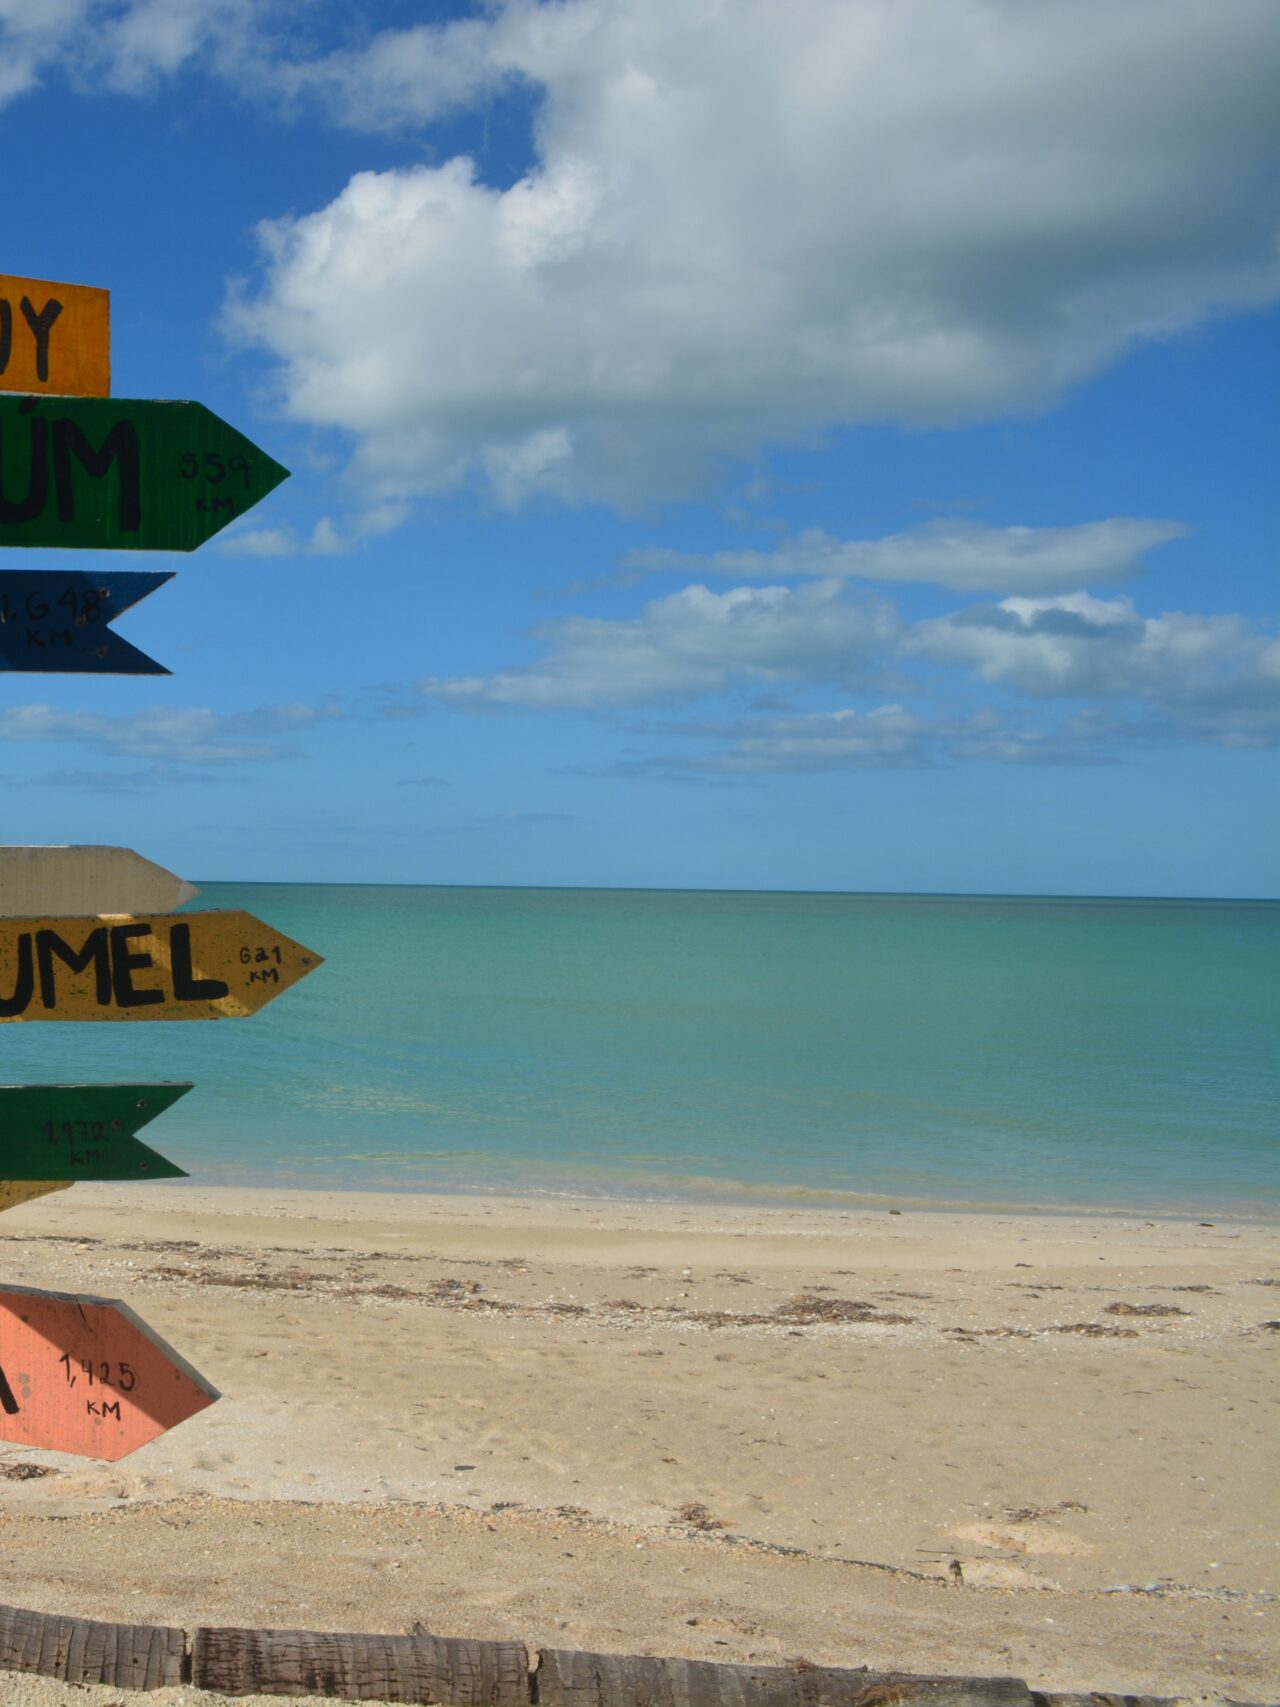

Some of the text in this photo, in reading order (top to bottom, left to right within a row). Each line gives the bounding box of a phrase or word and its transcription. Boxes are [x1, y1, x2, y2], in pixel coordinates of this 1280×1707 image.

[240, 945, 282, 965] 621
[249, 967, 279, 984] KM
[59, 1352, 136, 1392] 1,425
[86, 1400, 121, 1421] KM
